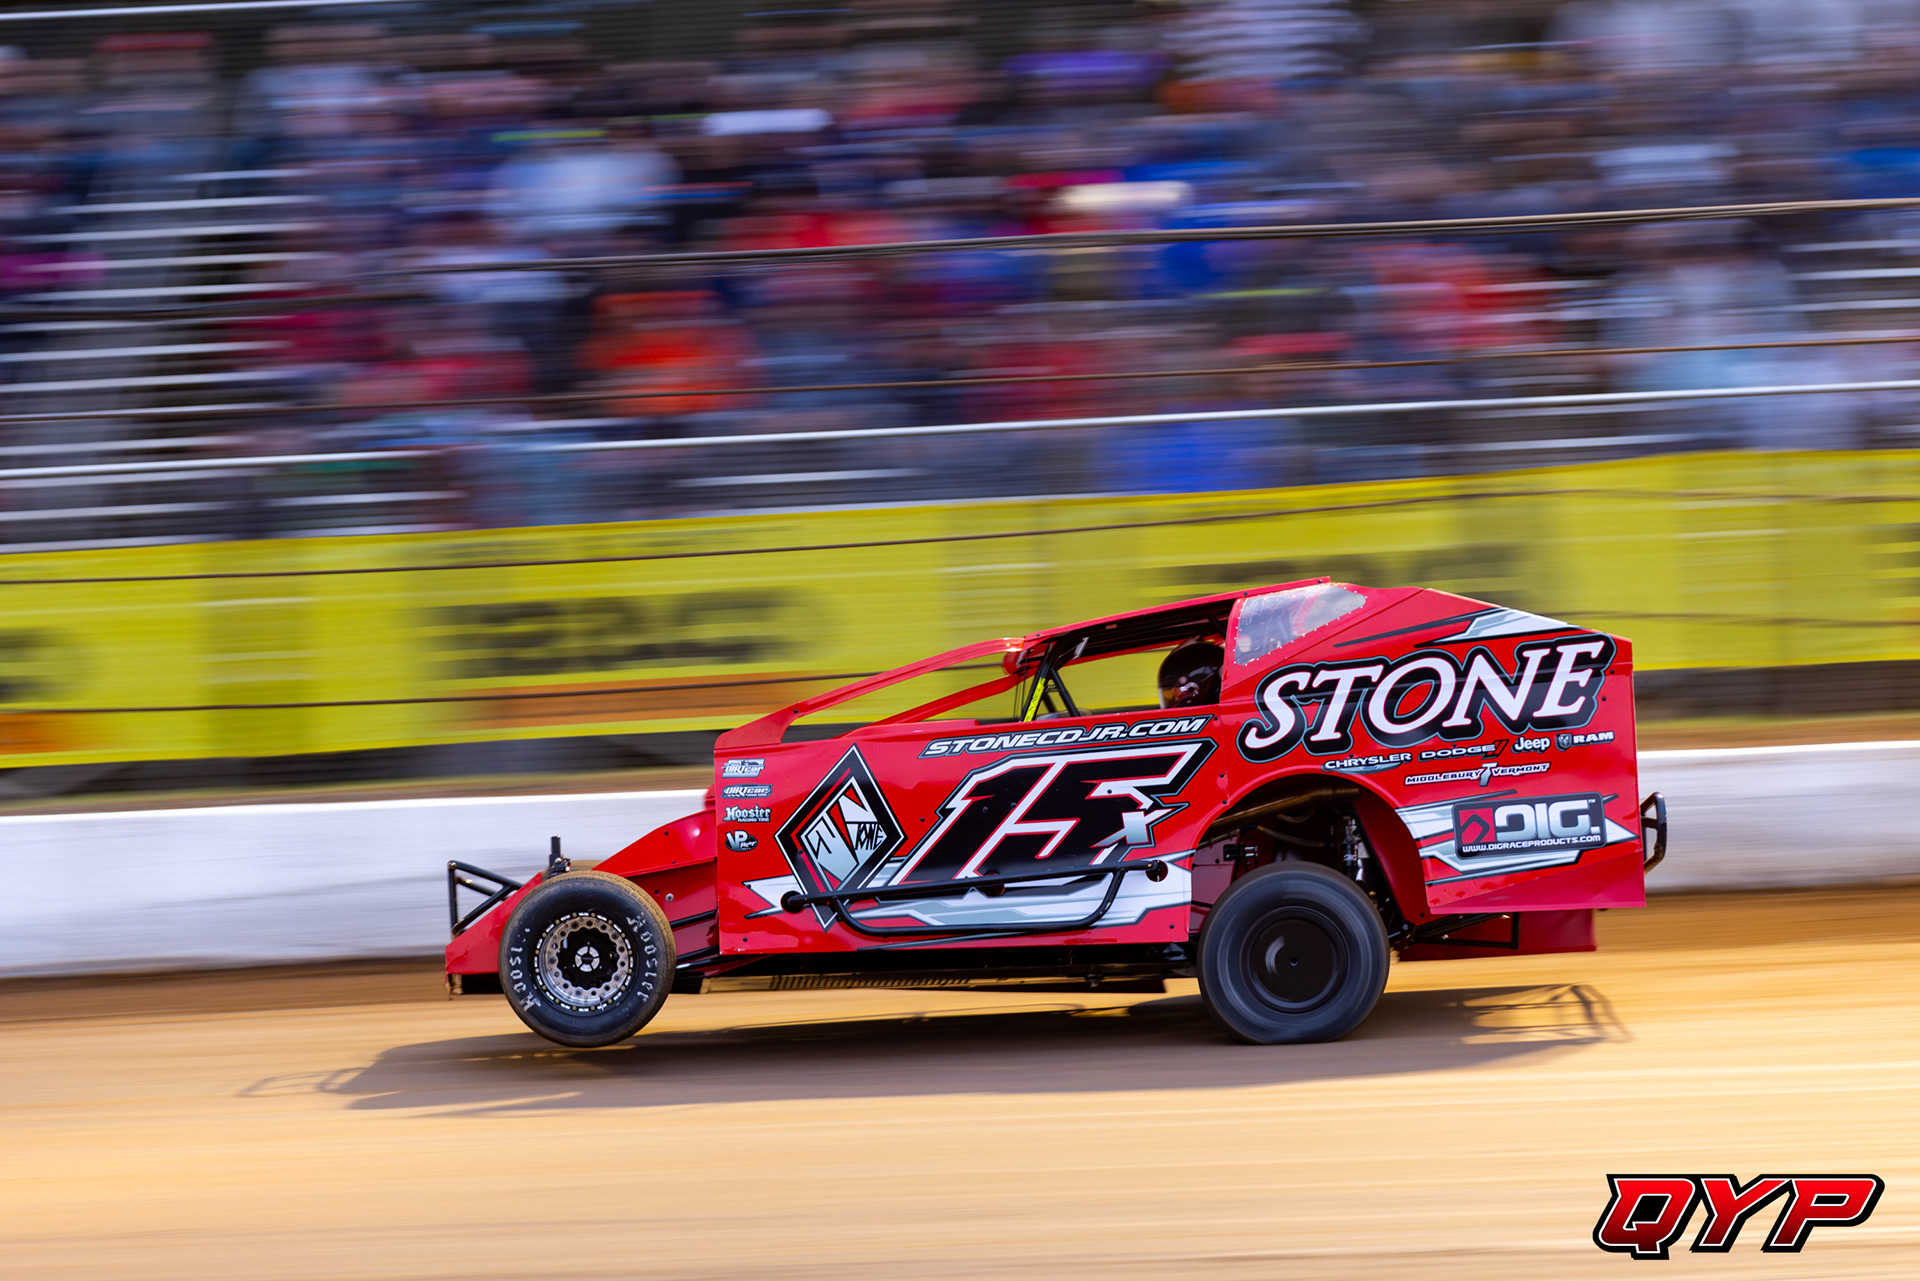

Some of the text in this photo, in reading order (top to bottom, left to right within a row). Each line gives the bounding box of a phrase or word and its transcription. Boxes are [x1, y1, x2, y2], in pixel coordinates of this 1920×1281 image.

[1244, 638, 1607, 750] STONE
[924, 717, 1208, 756] STONECDJR.COM
[1514, 737, 1551, 750] Jeep
[1573, 731, 1615, 744] RAM
[1421, 744, 1496, 759] DODGE
[1324, 753, 1412, 769] CHRYSLER
[1405, 768, 1483, 784] MIDDLEBURY
[1491, 763, 1550, 777] VERMONT
[723, 804, 772, 822] Hoosier
[726, 830, 749, 849] VP
